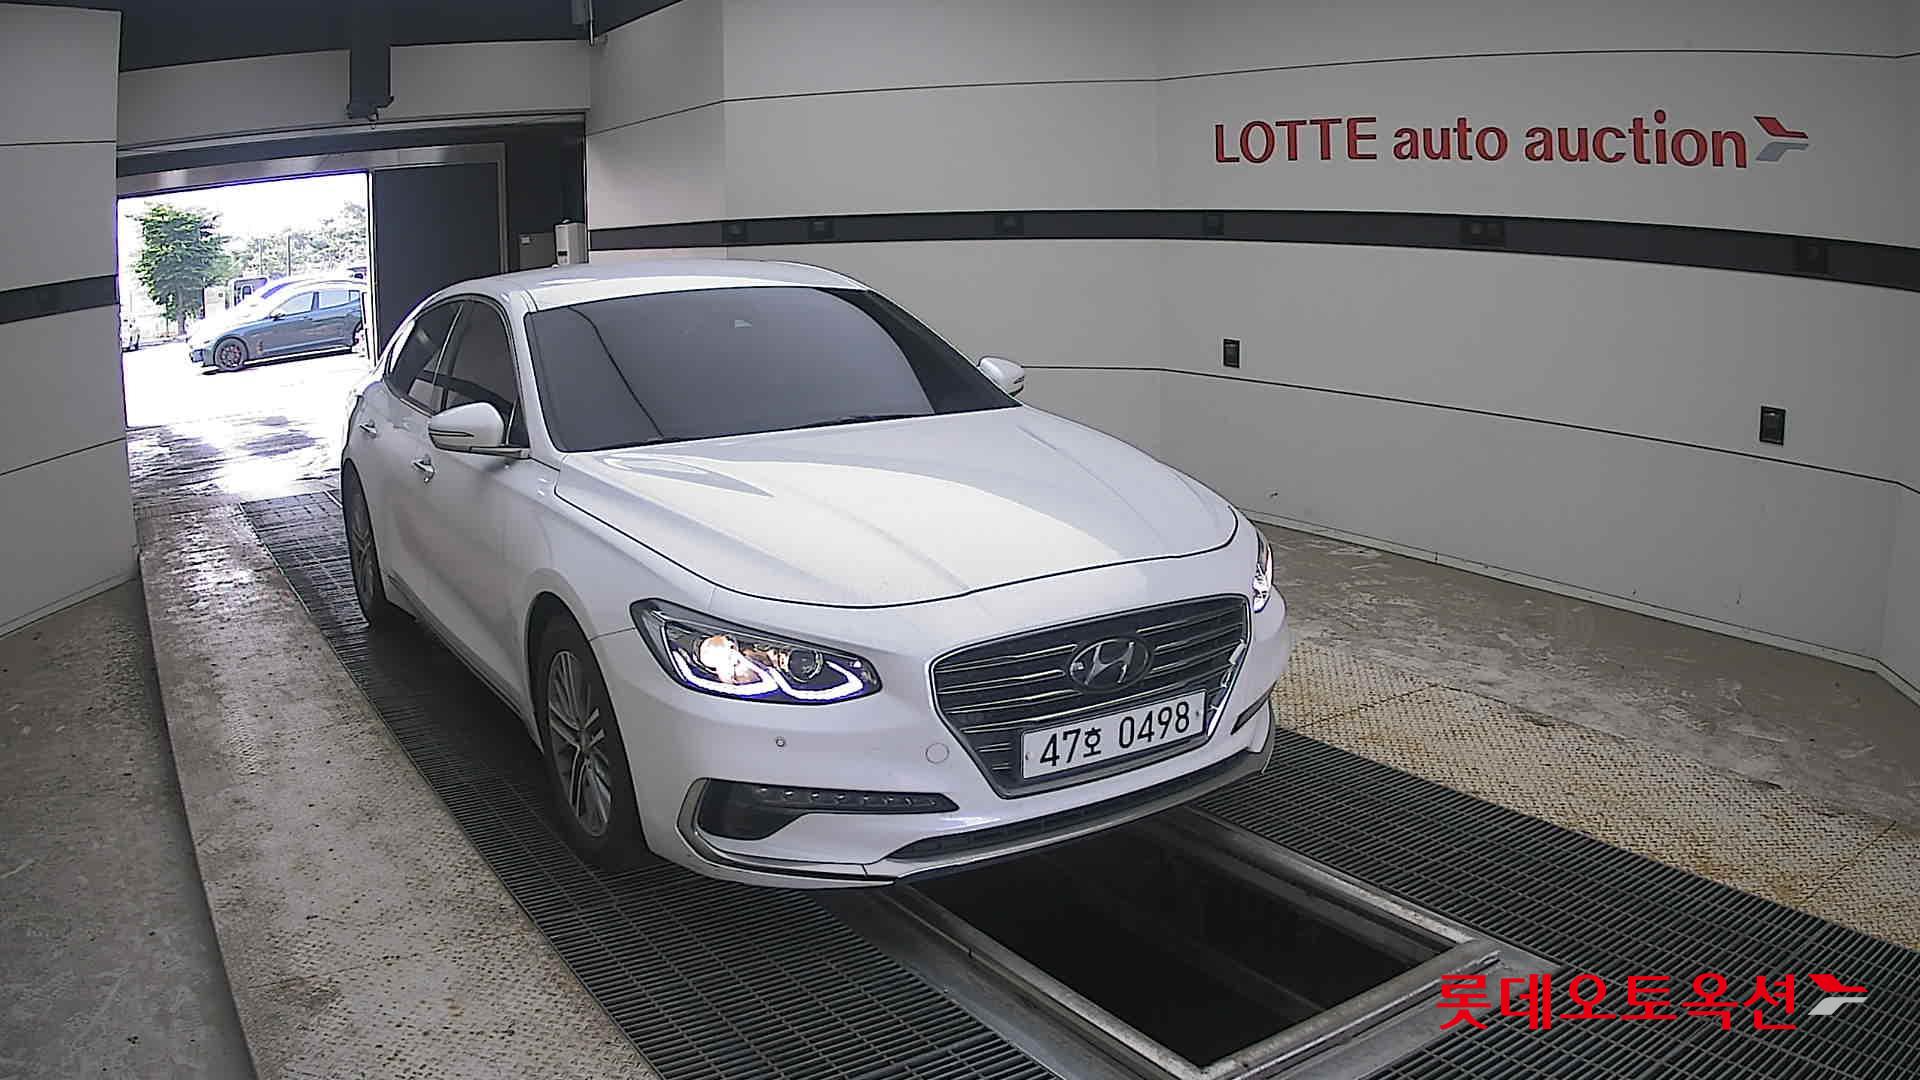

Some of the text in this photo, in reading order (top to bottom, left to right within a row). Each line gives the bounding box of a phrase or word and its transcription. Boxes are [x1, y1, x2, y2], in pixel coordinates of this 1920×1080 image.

[1214, 109, 1748, 169] LOTTE auto auction
[1039, 701, 1190, 767] 47호 0498
